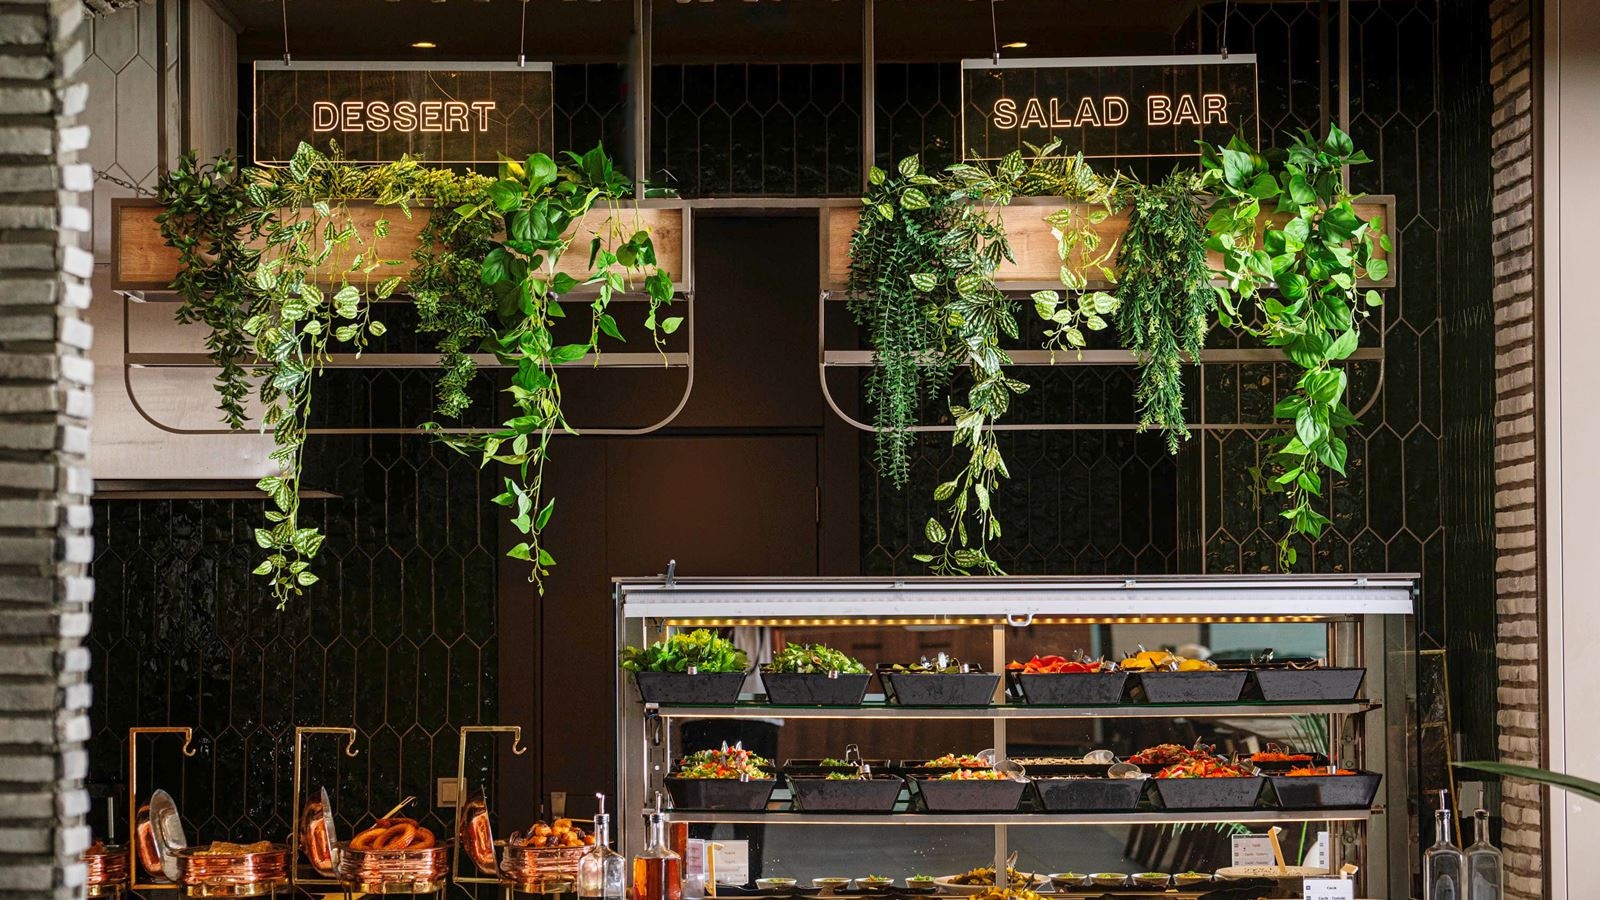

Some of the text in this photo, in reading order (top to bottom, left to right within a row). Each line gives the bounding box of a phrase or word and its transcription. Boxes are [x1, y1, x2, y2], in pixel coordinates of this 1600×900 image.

[313, 101, 496, 132] DESSERT
[993, 94, 1229, 130] SALAD BAR
